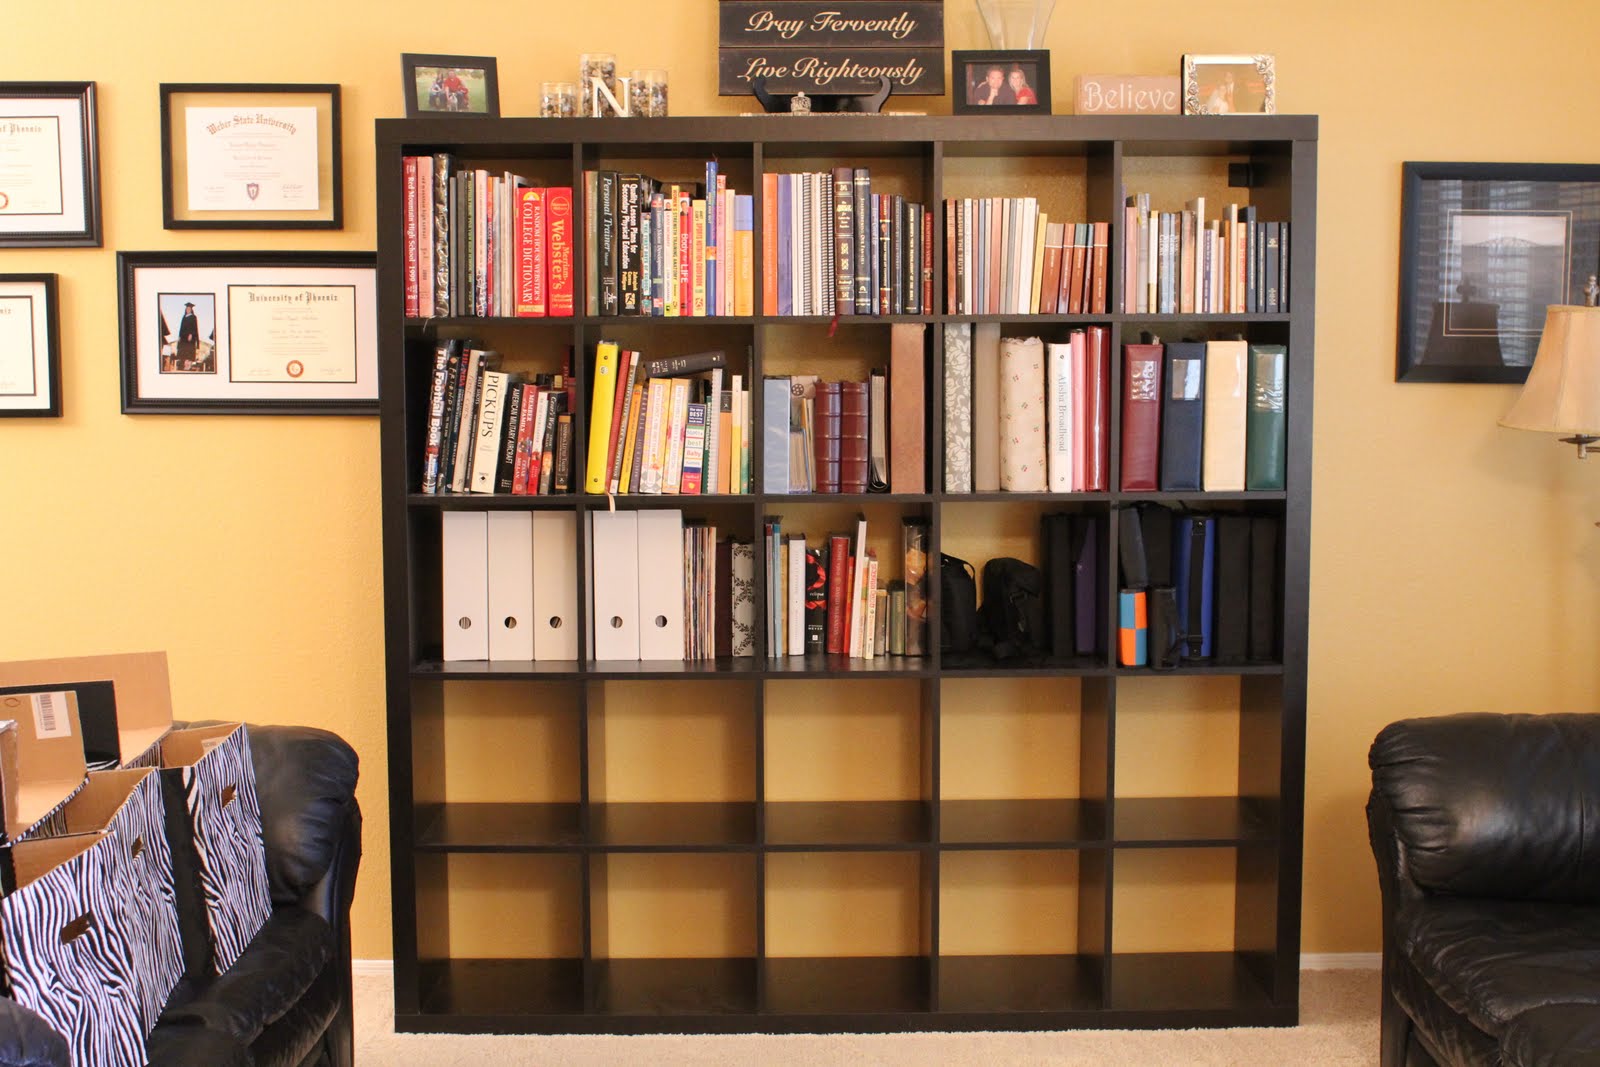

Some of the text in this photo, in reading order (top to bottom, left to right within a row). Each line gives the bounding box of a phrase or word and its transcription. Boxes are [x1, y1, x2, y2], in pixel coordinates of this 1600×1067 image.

[744, 10, 918, 39] Pray Fervently
[737, 57, 926, 86] Live Righteously
[589, 77, 632, 117] N
[1084, 82, 1176, 112] Believe
[206, 113, 297, 135] Weber State University
[603, 177, 612, 215] Personal
[621, 184, 629, 214] Secondary
[407, 223, 415, 239] High
[621, 215, 629, 240] Physical
[629, 184, 638, 254] Quality Lesson Plans for
[604, 218, 612, 251] Trainer
[680, 233, 688, 253] Body
[408, 241, 416, 262] School
[522, 202, 533, 304] COLLEGE DICTIONARY
[552, 219, 565, 290] Webster's
[562, 246, 570, 281] Merriam-
[680, 263, 688, 283] LIFE
[248, 291, 338, 304] University of Phoenix
[459, 367, 467, 387] NBA
[429, 349, 447, 446] The Football Book
[481, 374, 499, 438] PICKUPS
[526, 395, 534, 422] MEMBER
[506, 388, 520, 464] AMERICAN MILITARY AIRCRAFT
[547, 417, 555, 429] Way
[1058, 405, 1067, 452] Broadhead
